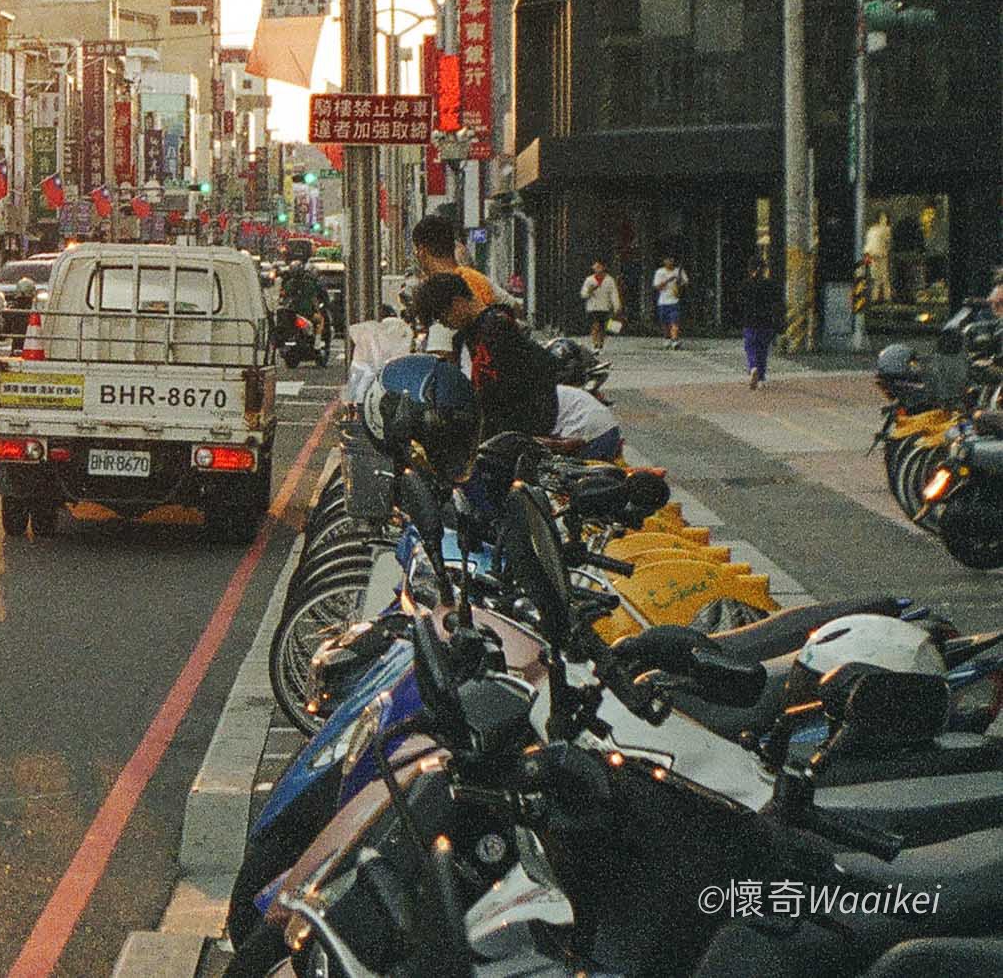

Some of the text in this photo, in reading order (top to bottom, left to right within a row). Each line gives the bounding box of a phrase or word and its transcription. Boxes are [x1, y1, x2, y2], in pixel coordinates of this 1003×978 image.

[315, 98, 429, 118] 騎樓禁止停車
[315, 118, 428, 139] 違者加強取締
[100, 384, 227, 408] BHR-8670
[91, 454, 149, 472] BHR-8670
